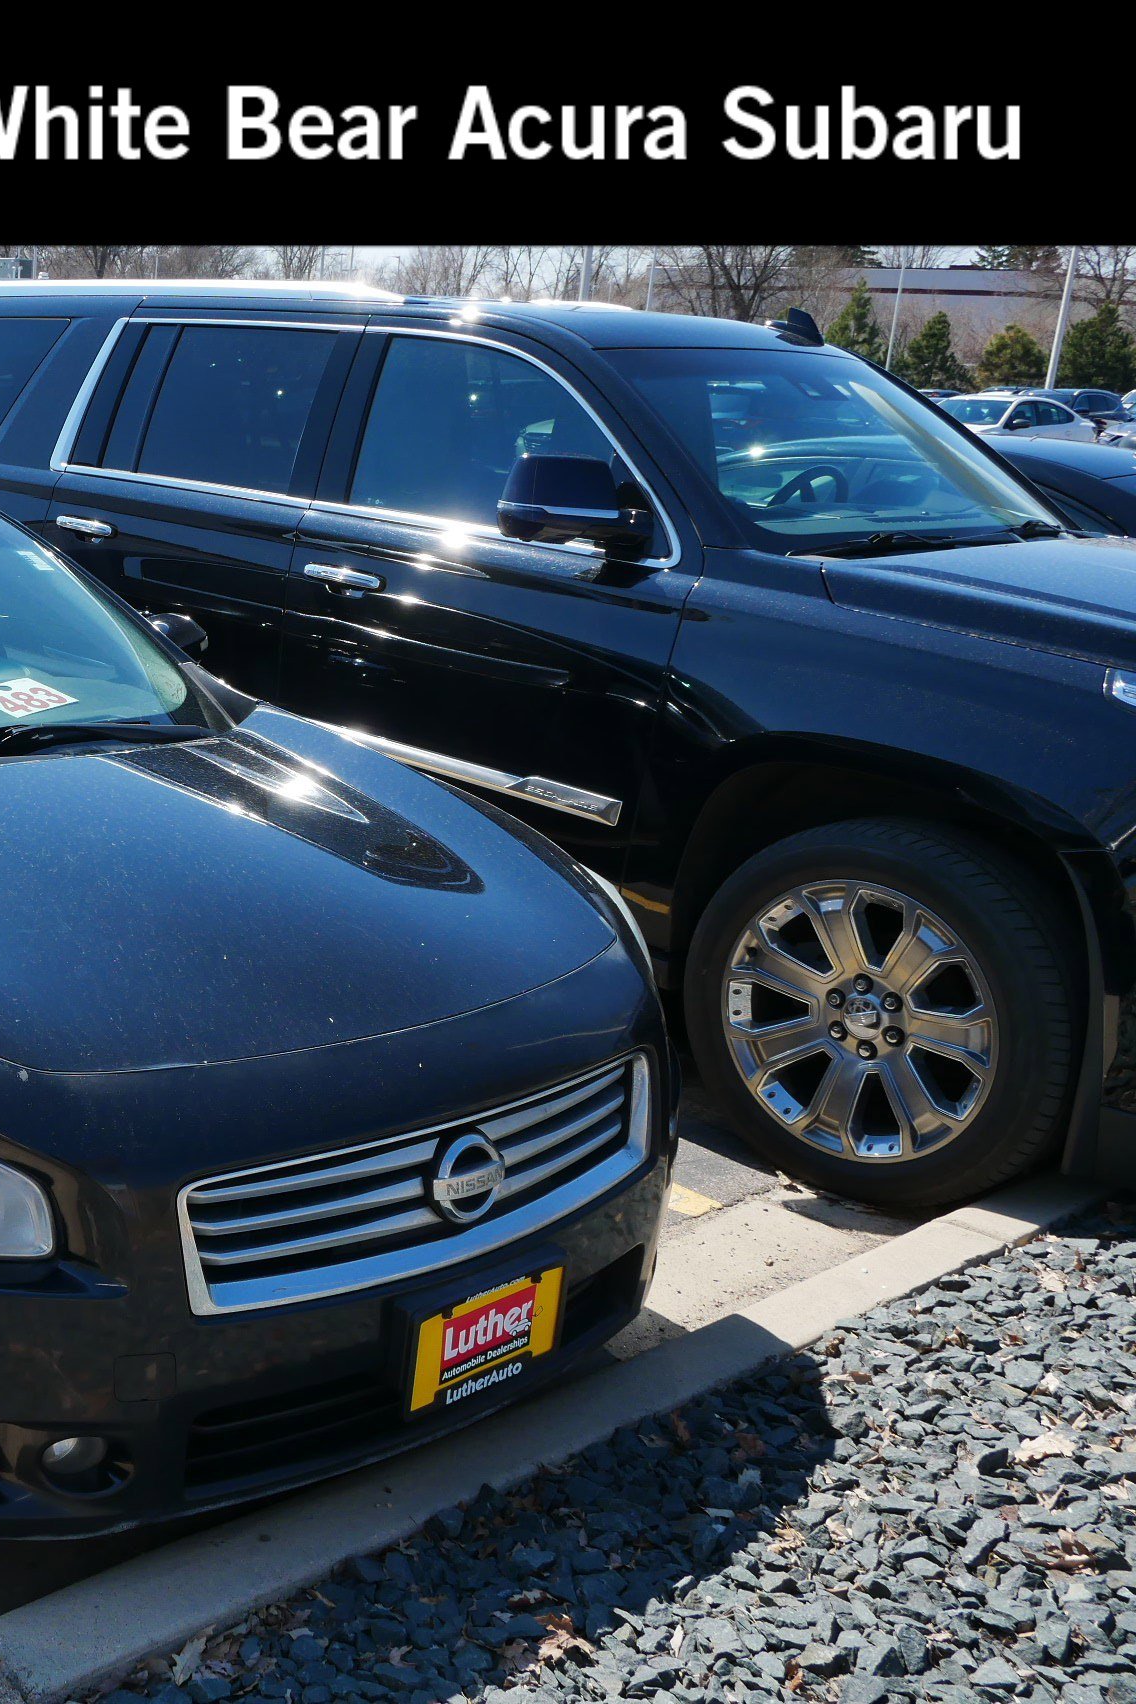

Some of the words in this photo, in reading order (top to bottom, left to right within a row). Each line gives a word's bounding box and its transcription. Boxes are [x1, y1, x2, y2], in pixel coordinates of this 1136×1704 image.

[446, 1168, 504, 1197] NISSAN
[443, 1300, 533, 1361] Luther
[441, 1354, 485, 1382] Automobile
[486, 1335, 529, 1360] Dealerships
[445, 1362, 523, 1405] LutherAuto
